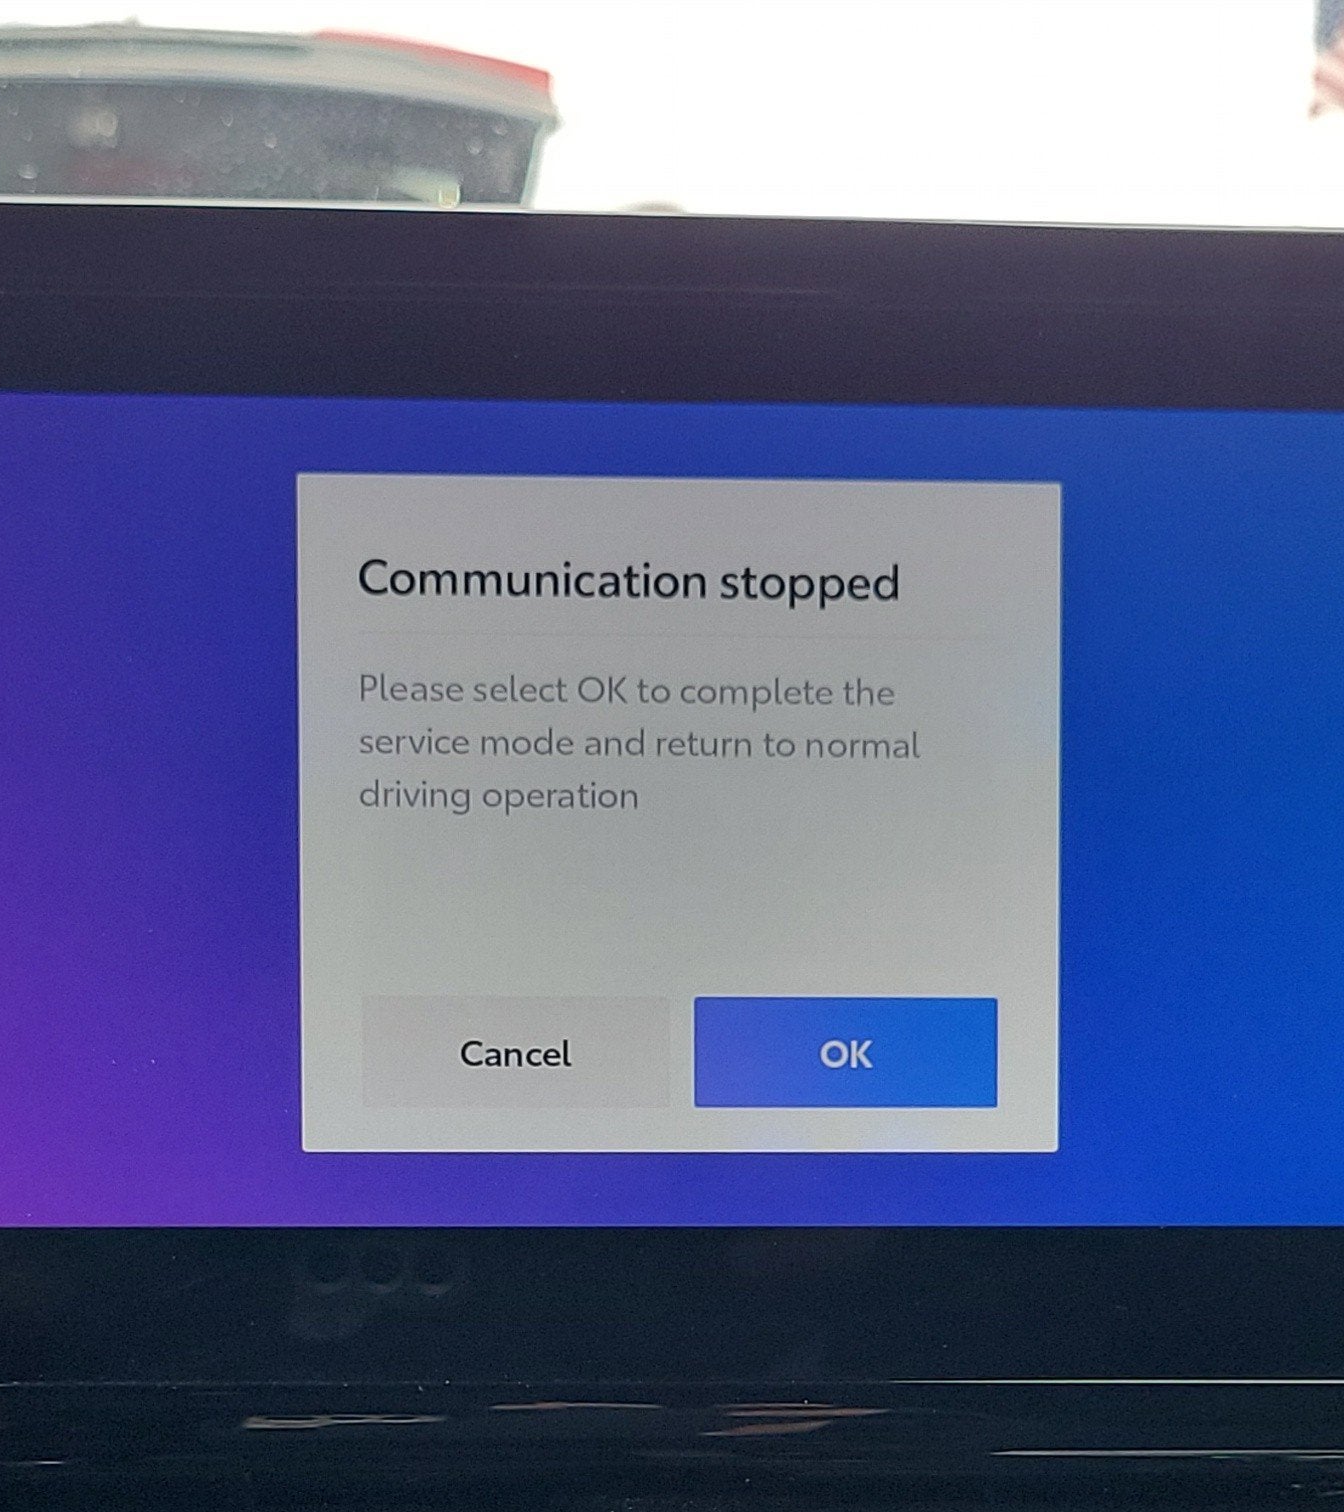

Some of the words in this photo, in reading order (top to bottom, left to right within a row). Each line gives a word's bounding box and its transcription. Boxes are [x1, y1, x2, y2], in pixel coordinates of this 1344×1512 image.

[358, 558, 706, 600] Communication
[720, 563, 899, 610] stopped
[359, 672, 464, 703] Please
[473, 673, 568, 704] select
[577, 675, 628, 704] OK
[636, 678, 671, 704] to
[680, 676, 834, 713] complete
[843, 677, 895, 706] the
[359, 728, 470, 756] service
[481, 726, 574, 756] mode
[584, 727, 645, 758] and
[656, 731, 752, 759] return
[763, 731, 796, 759] to
[806, 730, 921, 760] normal
[359, 778, 471, 816] driving
[482, 780, 638, 816] operation
[460, 1039, 572, 1068] Cancel
[820, 1039, 873, 1069] OK
